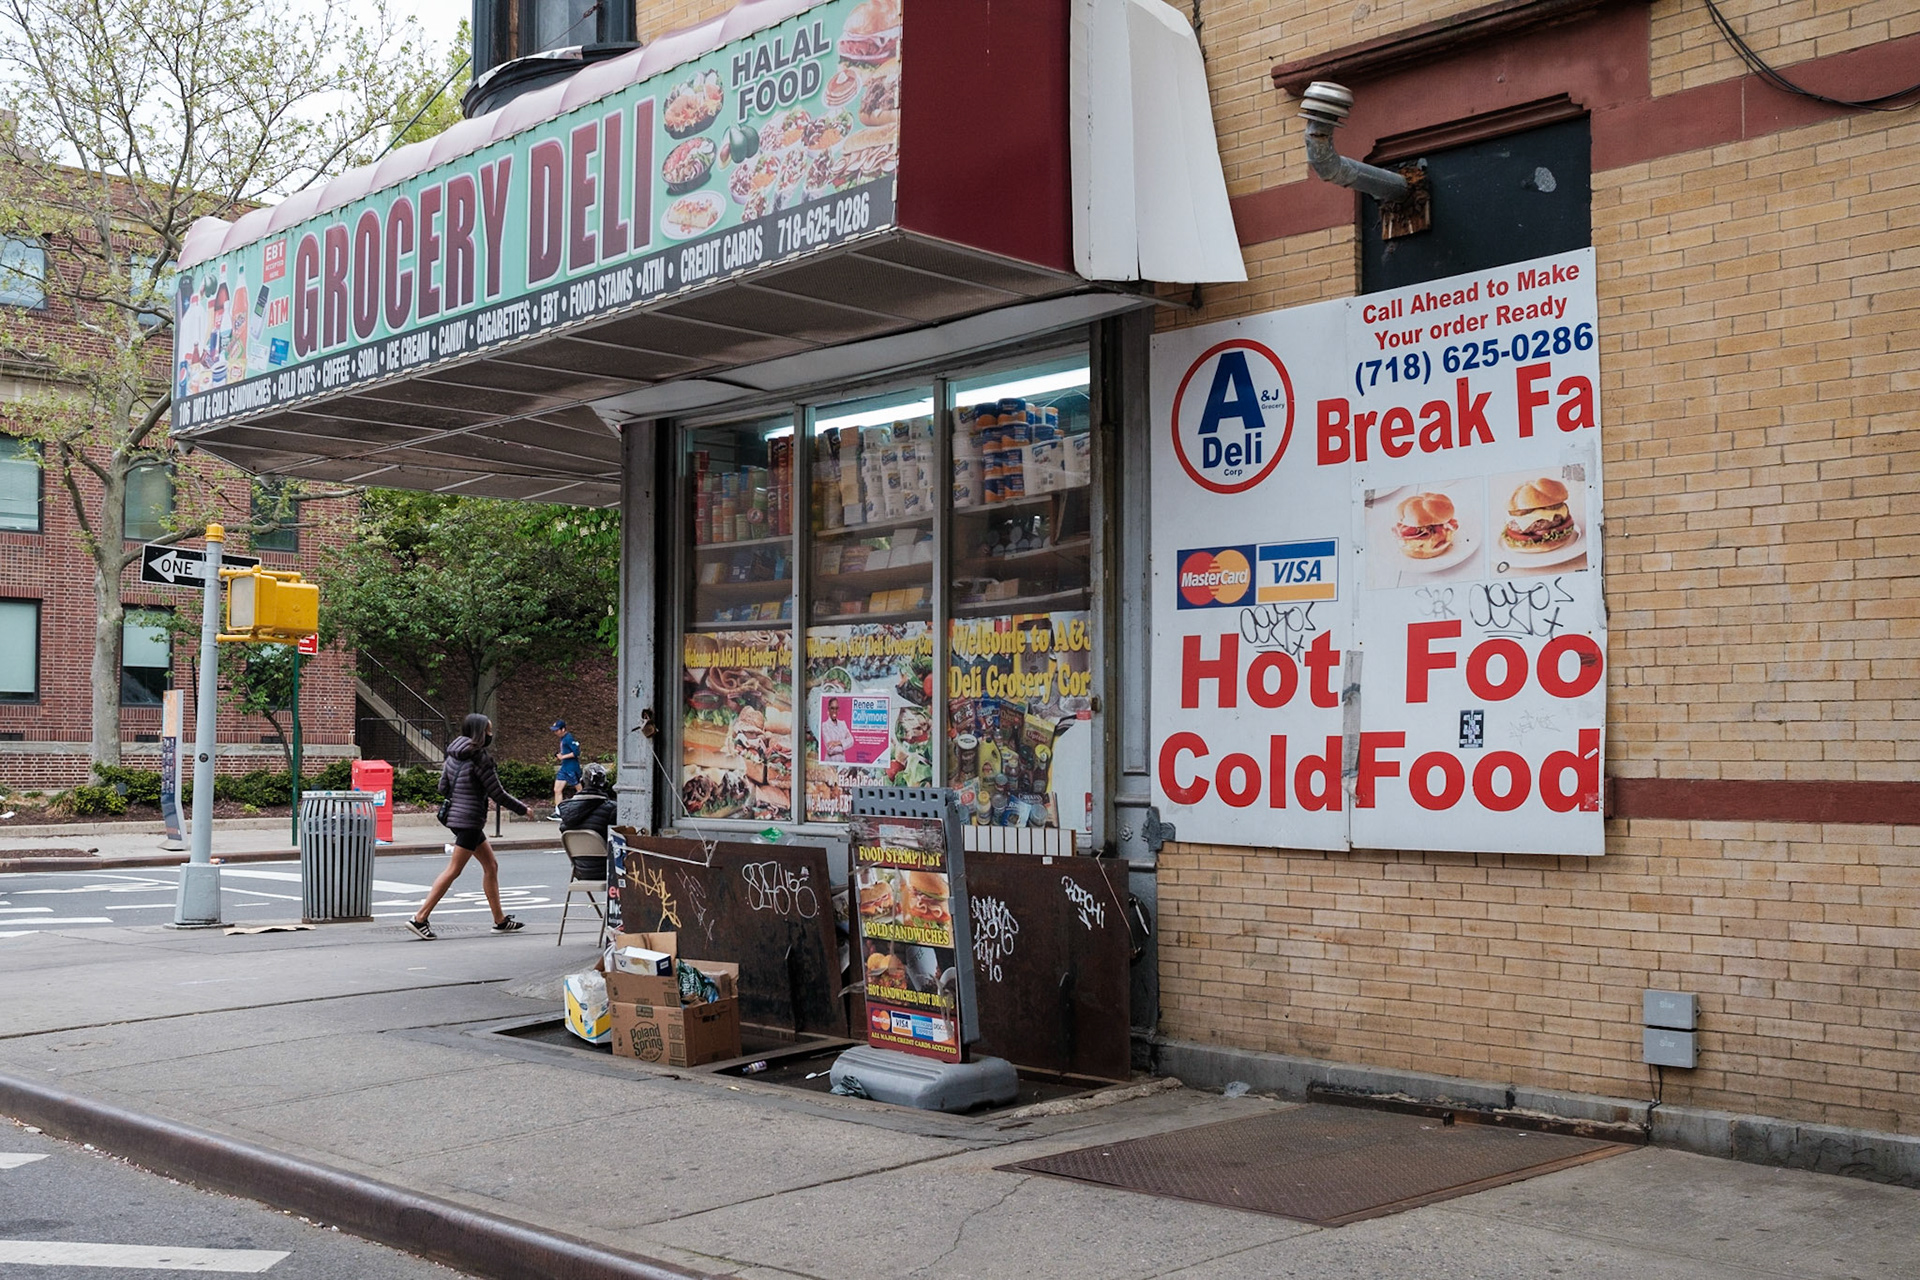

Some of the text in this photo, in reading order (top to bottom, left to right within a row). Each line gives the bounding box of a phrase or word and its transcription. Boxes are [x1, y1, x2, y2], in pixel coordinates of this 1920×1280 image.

[731, 20, 831, 88] HALAL
[738, 61, 821, 121] FOOD
[293, 98, 656, 358] GROCERY DELI
[266, 241, 285, 262] EBT
[1363, 263, 1581, 325] Call Ahead to Make
[192, 396, 206, 423] HOT
[205, 394, 212, 420] &
[211, 390, 228, 418] COLD
[229, 377, 272, 413] SANDWICHES
[278, 371, 296, 400] COLD
[297, 364, 316, 395] CUTS
[322, 354, 351, 388] COFFEE
[357, 346, 379, 379] SODA
[386, 339, 400, 371] ICE
[401, 331, 430, 366] CREAM
[438, 319, 468, 355] CANDY
[476, 300, 531, 345] CIGARETTES
[540, 290, 560, 326] EBT
[569, 278, 596, 318] FOOD
[598, 266, 634, 309] STAMS
[641, 256, 665, 296] ATM
[680, 238, 722, 283] CREDIT
[723, 225, 764, 271] CARDS
[777, 191, 870, 254] 718-625-0286
[267, 295, 290, 328] ATM
[1374, 295, 1568, 350] Your order Ready
[1355, 322, 1594, 397] (718) 625-0286
[1198, 351, 1266, 435] A
[1261, 402, 1286, 411] Grocery
[1316, 362, 1596, 466] Break Fa
[1203, 431, 1262, 469] Deli
[1223, 468, 1243, 477] Corp
[161, 558, 194, 576] ONE
[1181, 568, 1249, 588] MasterCard
[1272, 559, 1322, 584] VISA
[867, 635, 884, 657] Deli
[884, 635, 917, 660] Grocery
[952, 623, 1027, 656] Welcome
[1030, 624, 1050, 653] to
[684, 648, 712, 668] Welcome
[736, 647, 750, 667] Deli
[750, 647, 777, 670] Grocery
[1181, 629, 1341, 709] Hot
[1405, 620, 1604, 704] Foo
[949, 663, 1091, 705] Deli Grocery Cor
[853, 699, 875, 709] Renee
[853, 710, 887, 724] Collymore
[838, 774, 884, 787] Halal Food
[1158, 731, 1345, 812] Cold
[1355, 728, 1601, 813] Food
[859, 845, 885, 862] FOOD
[866, 921, 950, 945] COLD SANDWICHES
[867, 983, 880, 997] HOT
[630, 1023, 661, 1043] Poland
[895, 1018, 909, 1029] VISA
[633, 1037, 664, 1057] Spring
[871, 1031, 957, 1055] ALL MAJOR CREDIT CARDS ACCEPTED
